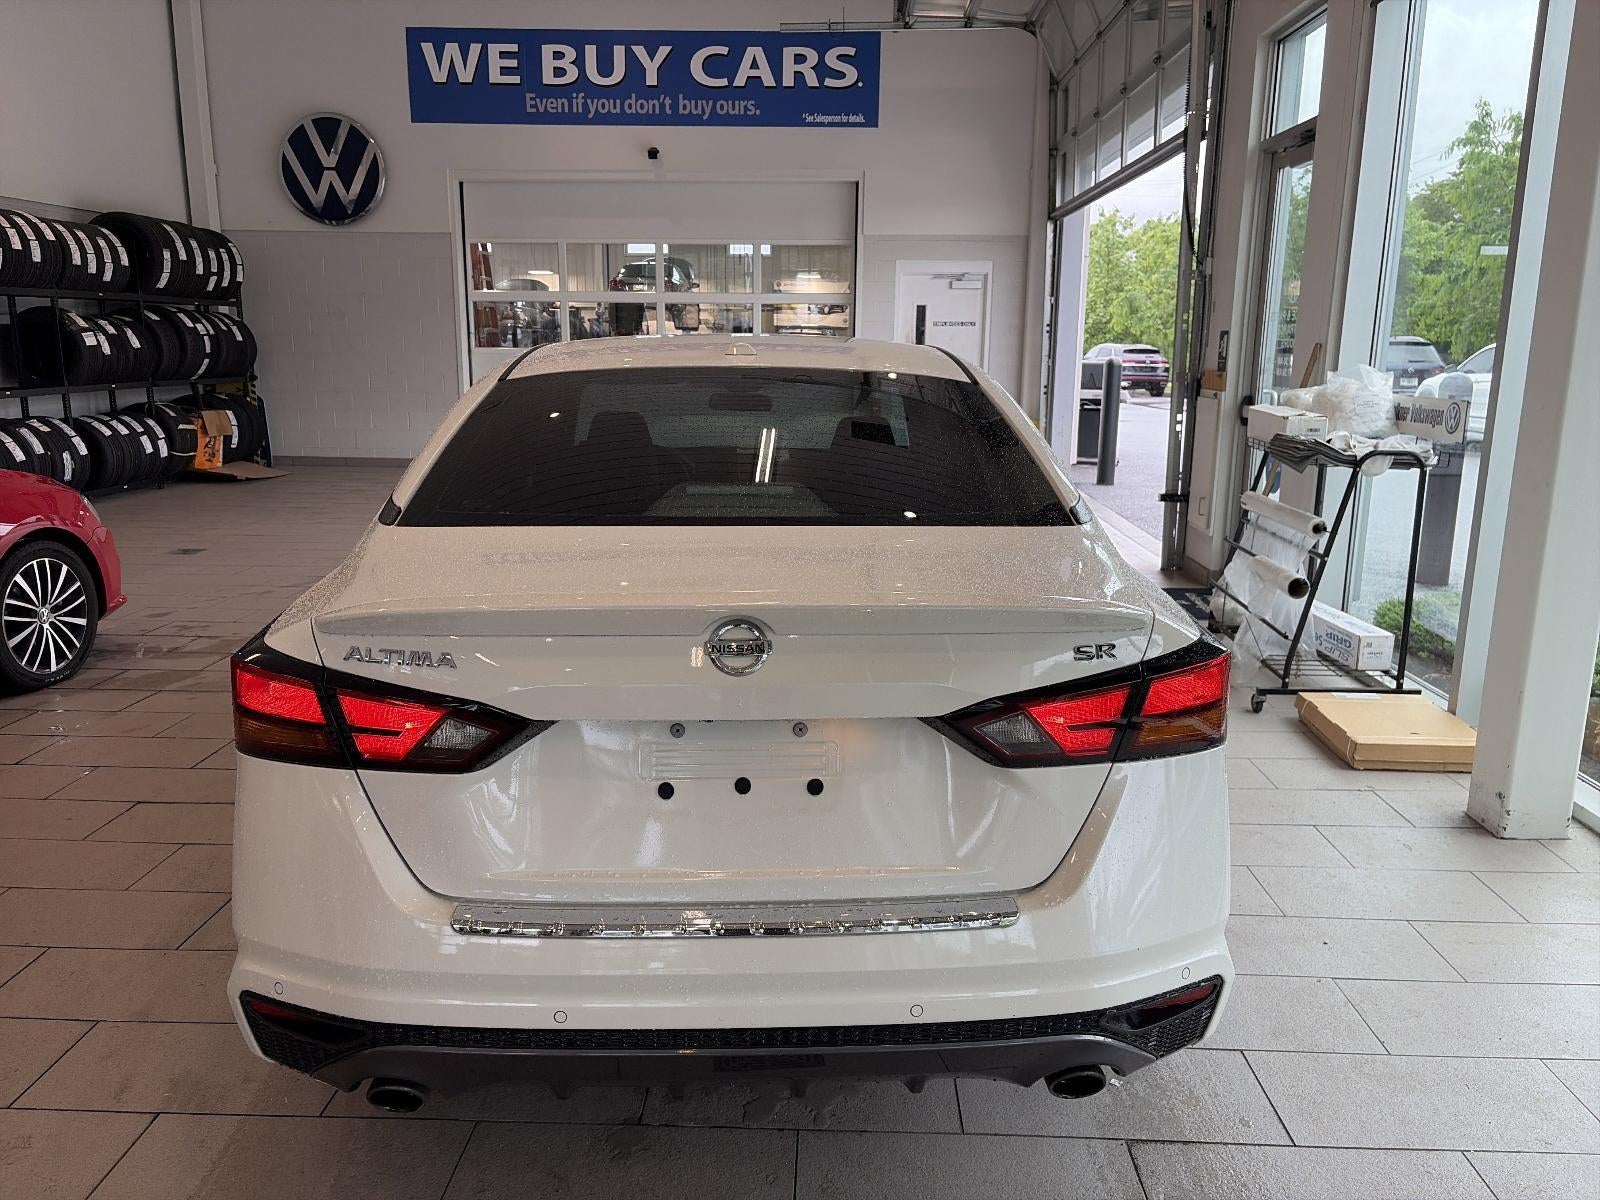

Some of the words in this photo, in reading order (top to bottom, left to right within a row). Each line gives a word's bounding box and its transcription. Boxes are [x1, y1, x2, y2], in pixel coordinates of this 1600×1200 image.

[420, 42, 521, 85] WE
[541, 44, 673, 87] BUY
[690, 45, 864, 88] CARS.
[525, 92, 569, 113] Even
[572, 92, 585, 113] if
[588, 97, 620, 119] you
[624, 93, 672, 115] don’t
[678, 94, 713, 120] buy
[715, 100, 761, 116] ours.
[814, 112, 841, 125] Salesperson
[841, 112, 849, 123] for
[849, 112, 866, 123] details.
[1410, 403, 1444, 428] Volkswagen
[710, 642, 767, 655] NISSAN
[1325, 632, 1352, 648] GRIP
[342, 645, 458, 669] ALTIMA
[1073, 642, 1117, 661] SR
[1325, 646, 1349, 661] SLIP
